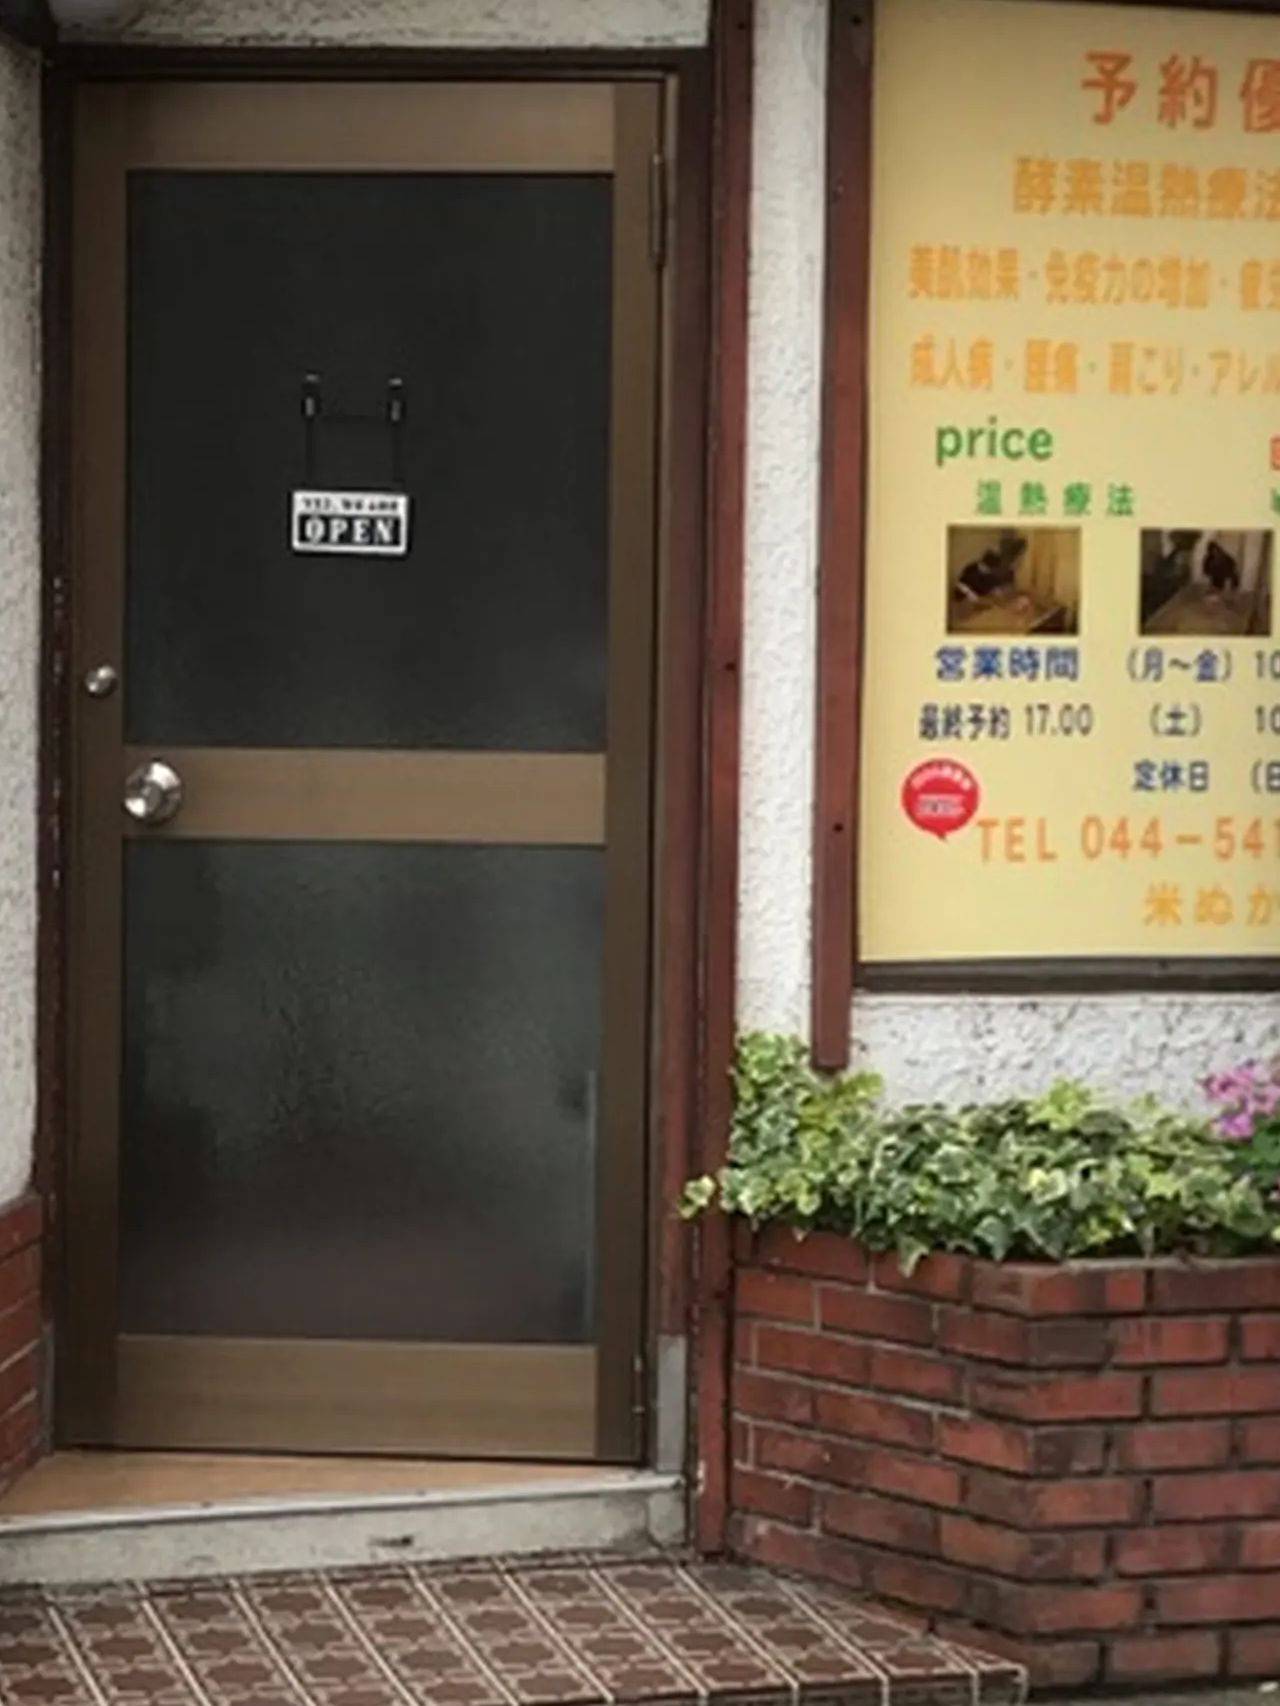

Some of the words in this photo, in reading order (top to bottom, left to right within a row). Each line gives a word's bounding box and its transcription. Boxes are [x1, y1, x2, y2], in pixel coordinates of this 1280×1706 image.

[935, 416, 1054, 467] price
[976, 480, 1135, 517] 温熱療法
[305, 516, 393, 544] OPEN
[935, 647, 1079, 681] 営業時間
[919, 703, 1011, 740] 最終予約
[1132, 760, 1209, 793] 定休日
[977, 816, 1058, 863] TEL
